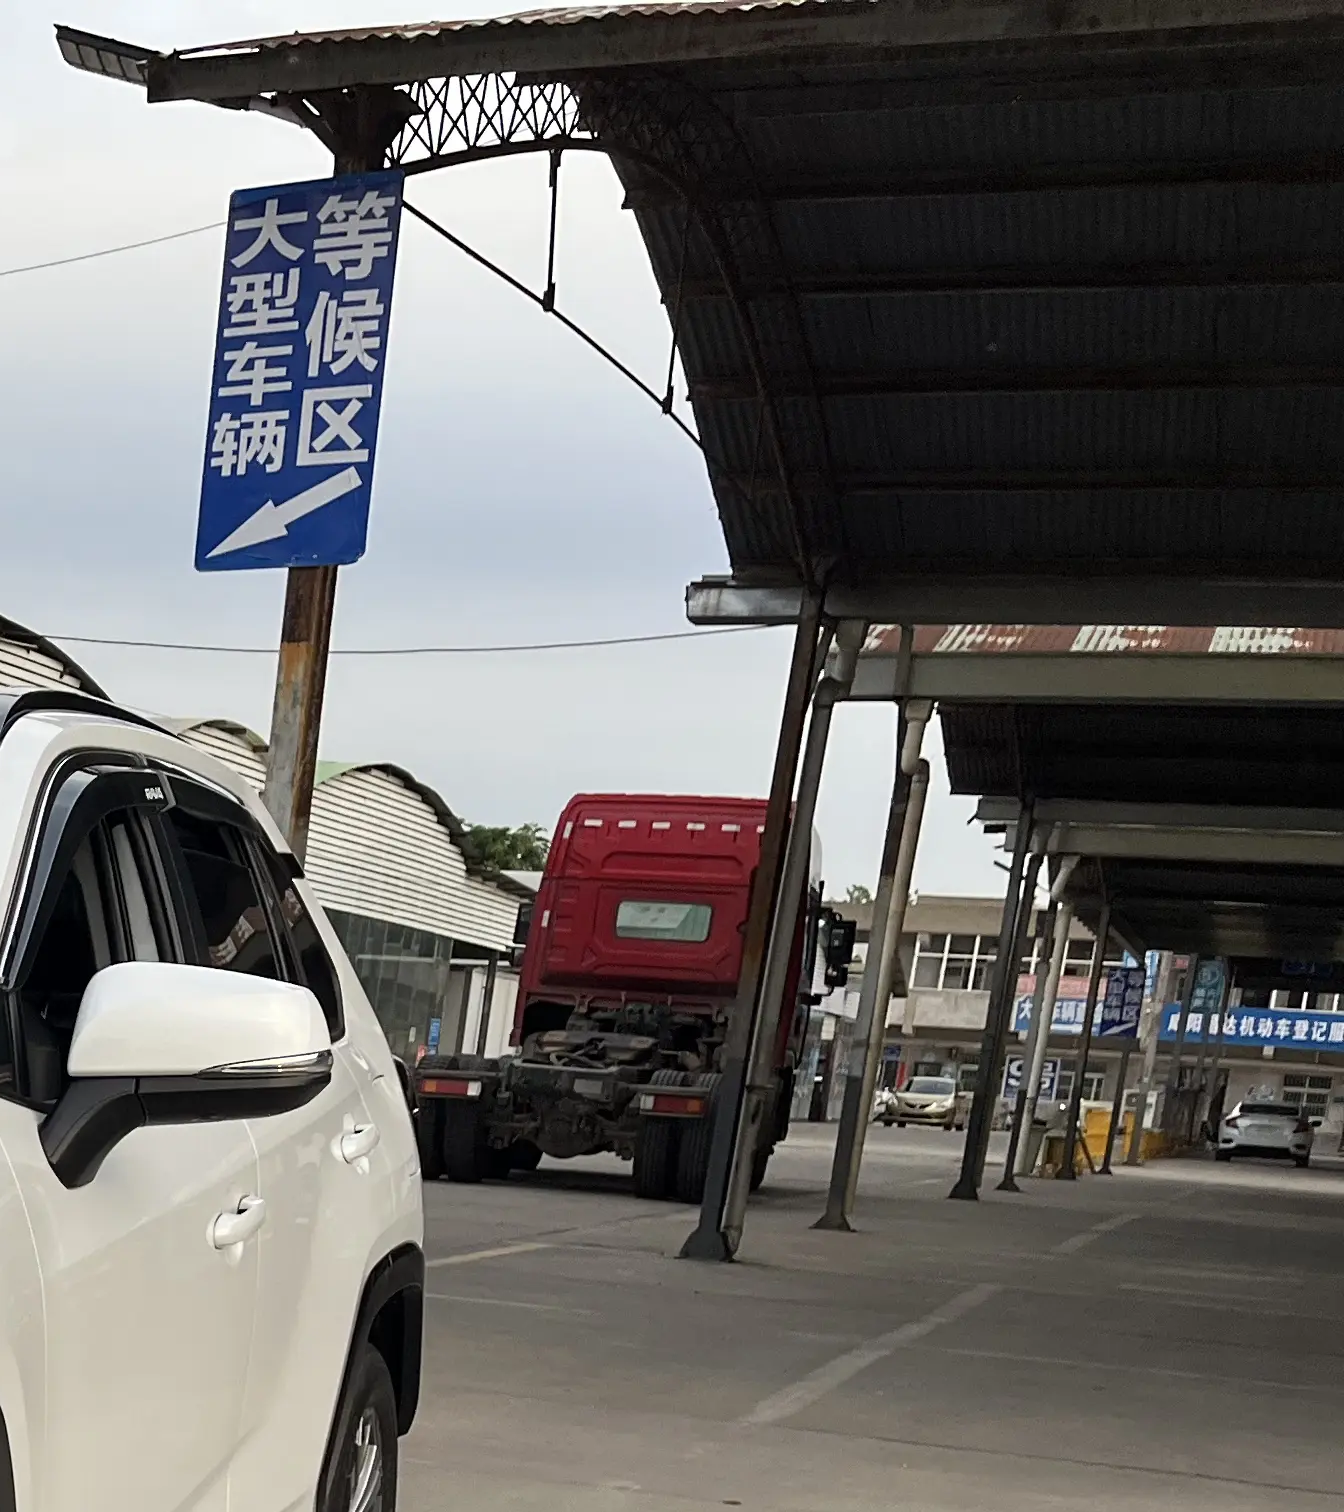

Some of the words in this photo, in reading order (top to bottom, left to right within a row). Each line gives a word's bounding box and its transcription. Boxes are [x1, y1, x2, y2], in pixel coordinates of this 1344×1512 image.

[210, 198, 308, 477] 大型车辆
[295, 190, 396, 468] 等候区
